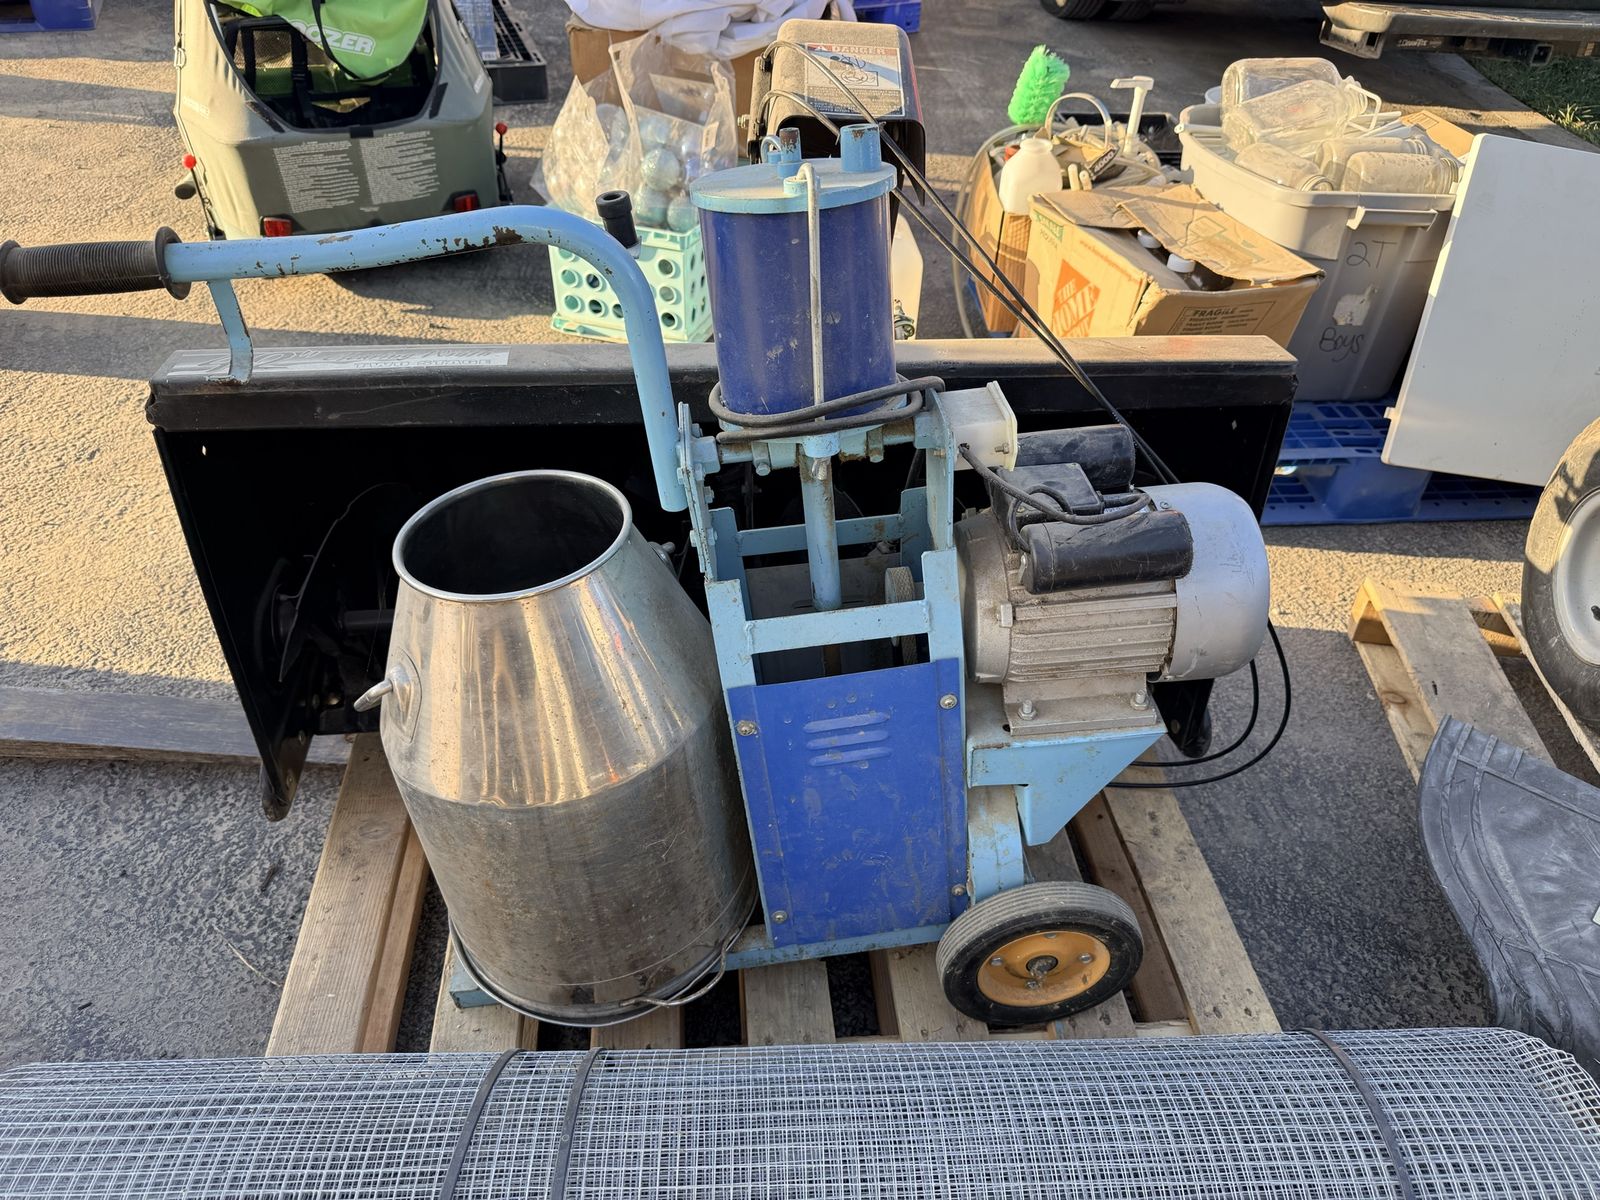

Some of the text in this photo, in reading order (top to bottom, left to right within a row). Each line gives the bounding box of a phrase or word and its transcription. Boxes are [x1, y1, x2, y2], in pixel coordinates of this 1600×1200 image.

[831, 45, 886, 55] DANGER
[1346, 240, 1397, 269] 2T
[1052, 284, 1099, 337] HOME
[1193, 307, 1238, 317] FRAGILE
[1319, 326, 1364, 363] Boys
